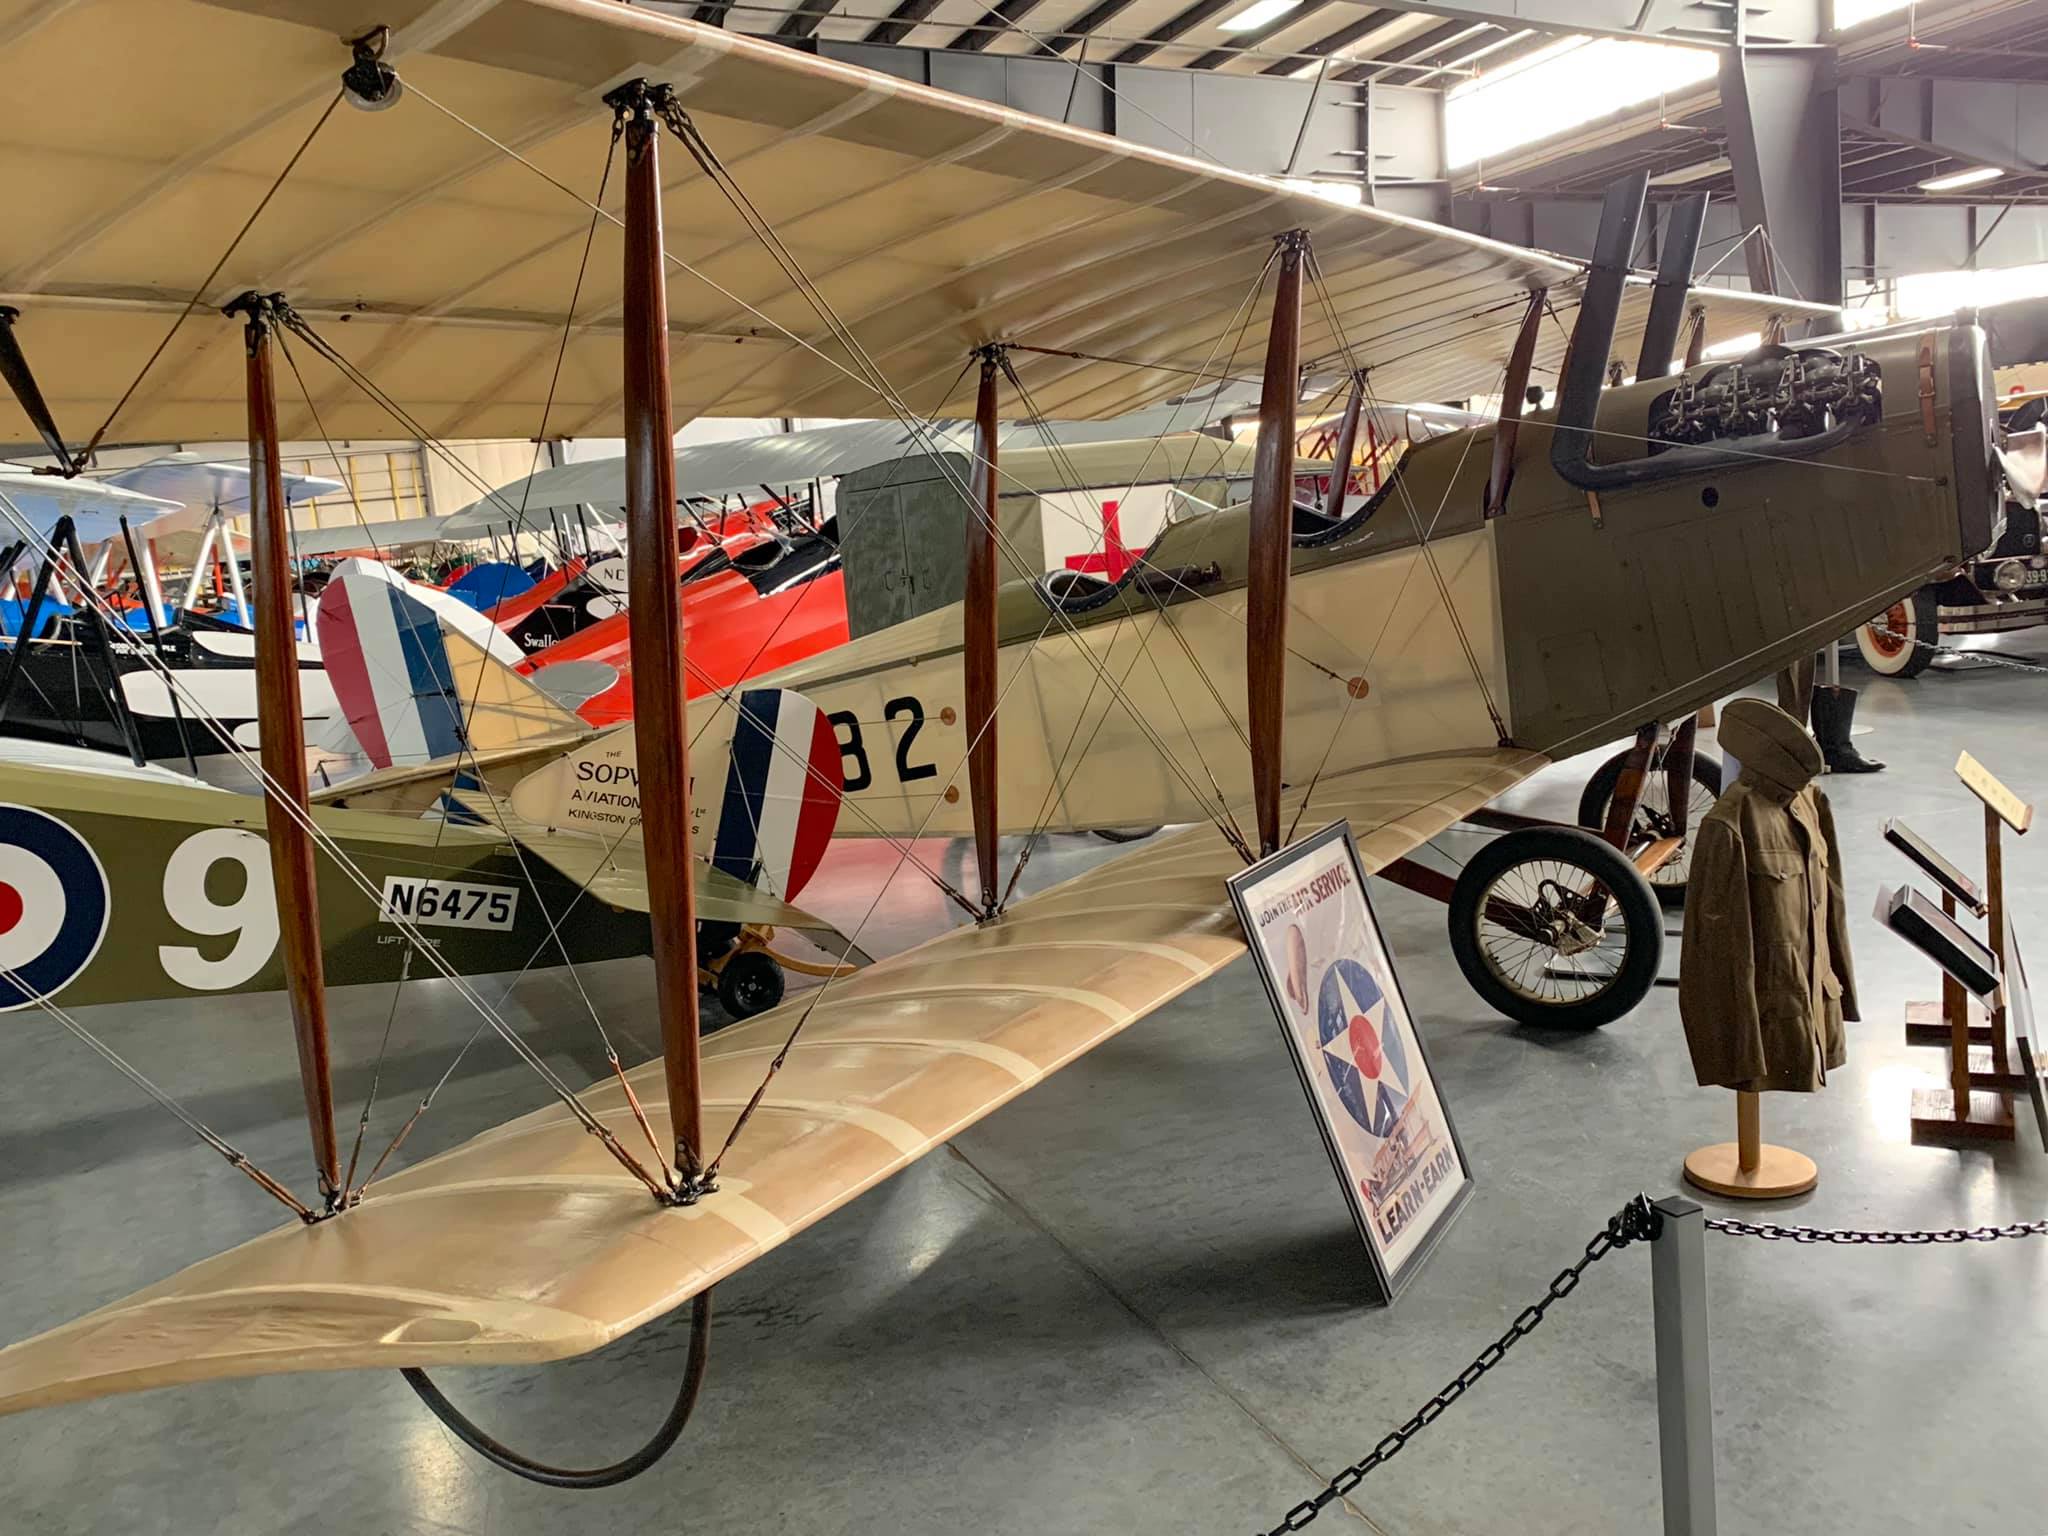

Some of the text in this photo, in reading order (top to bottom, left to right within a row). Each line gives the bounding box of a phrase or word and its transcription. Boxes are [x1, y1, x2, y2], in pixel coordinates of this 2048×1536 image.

[524, 632, 560, 648] Swallo
[568, 808, 626, 825] KINGSTON
[158, 828, 281, 990] 9
[388, 884, 512, 923] N6475
[1260, 907, 1280, 928] JOIN
[1310, 862, 1351, 904] SERVICE
[377, 935, 404, 945] LIFT
